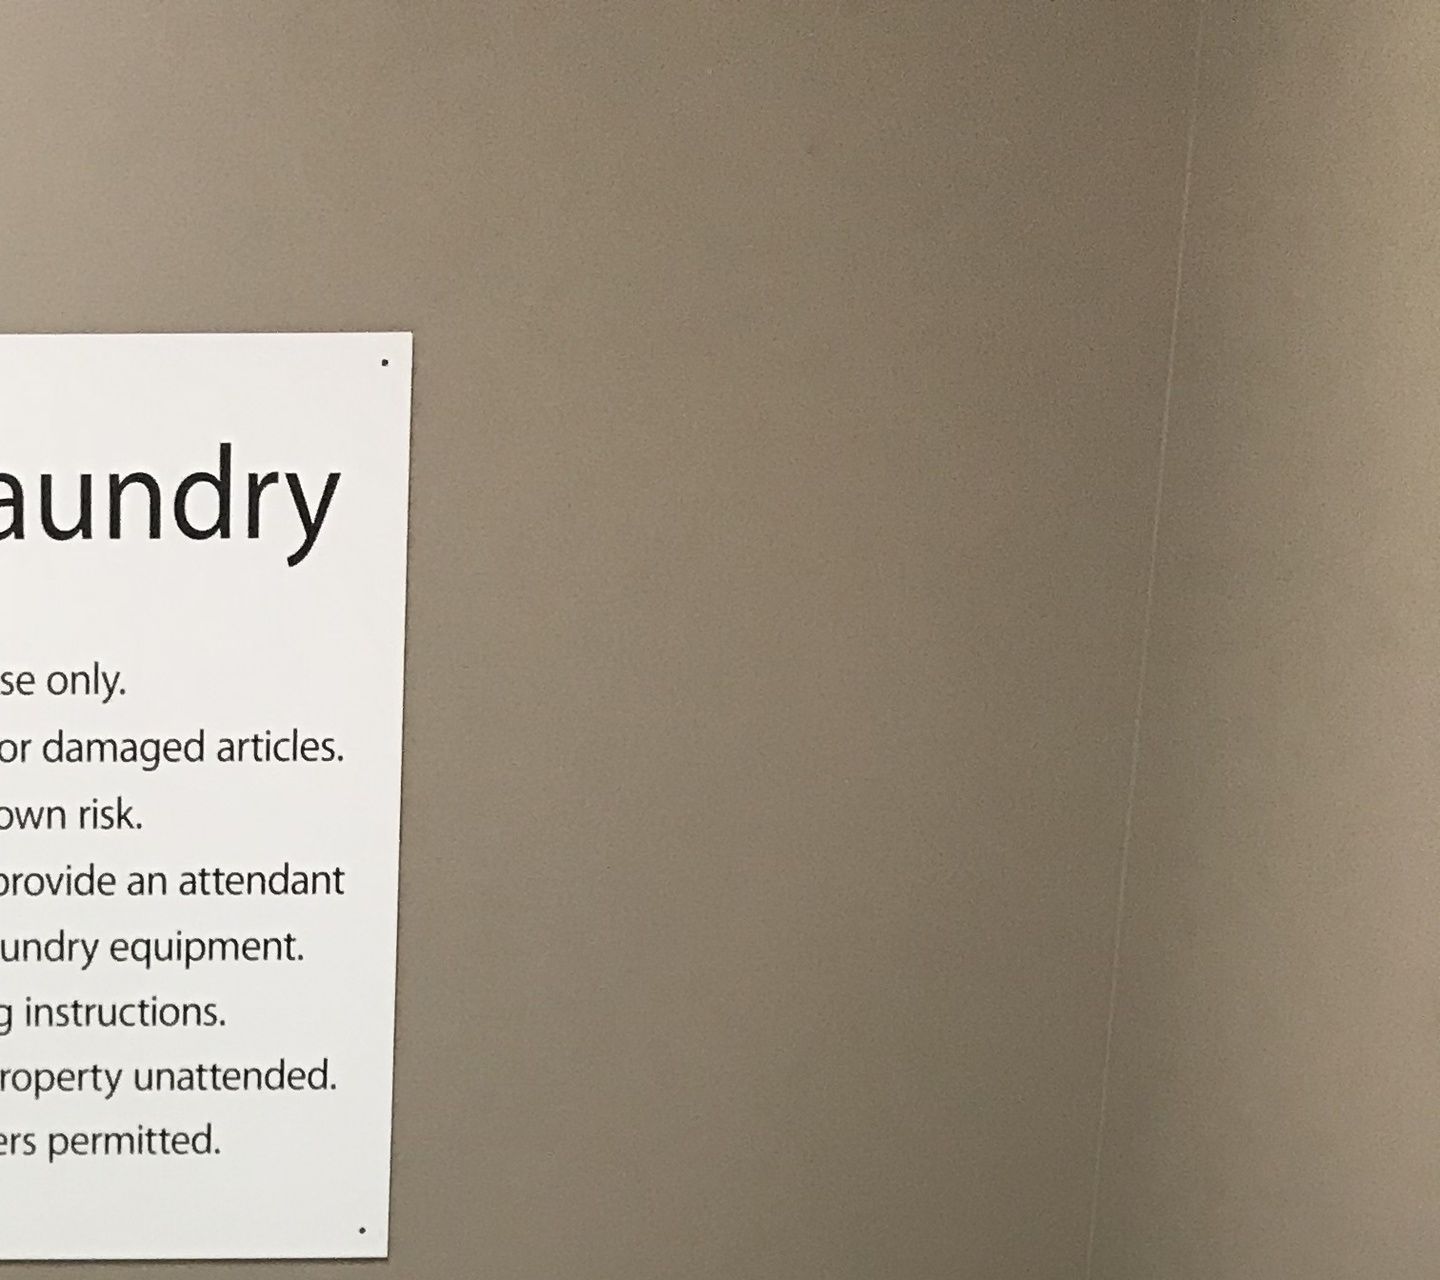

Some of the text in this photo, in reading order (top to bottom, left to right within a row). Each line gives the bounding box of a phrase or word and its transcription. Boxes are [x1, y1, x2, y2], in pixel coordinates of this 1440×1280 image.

[46, 660, 126, 705] only.
[42, 728, 205, 772] damaged
[216, 727, 344, 763] articles.
[79, 795, 143, 831] risk.
[126, 871, 167, 897] an
[179, 861, 346, 896] attendant
[109, 930, 304, 970] equipment.
[25, 995, 226, 1028] instructions.
[134, 1057, 337, 1092] unattended.
[48, 1122, 221, 1164] permitted.
